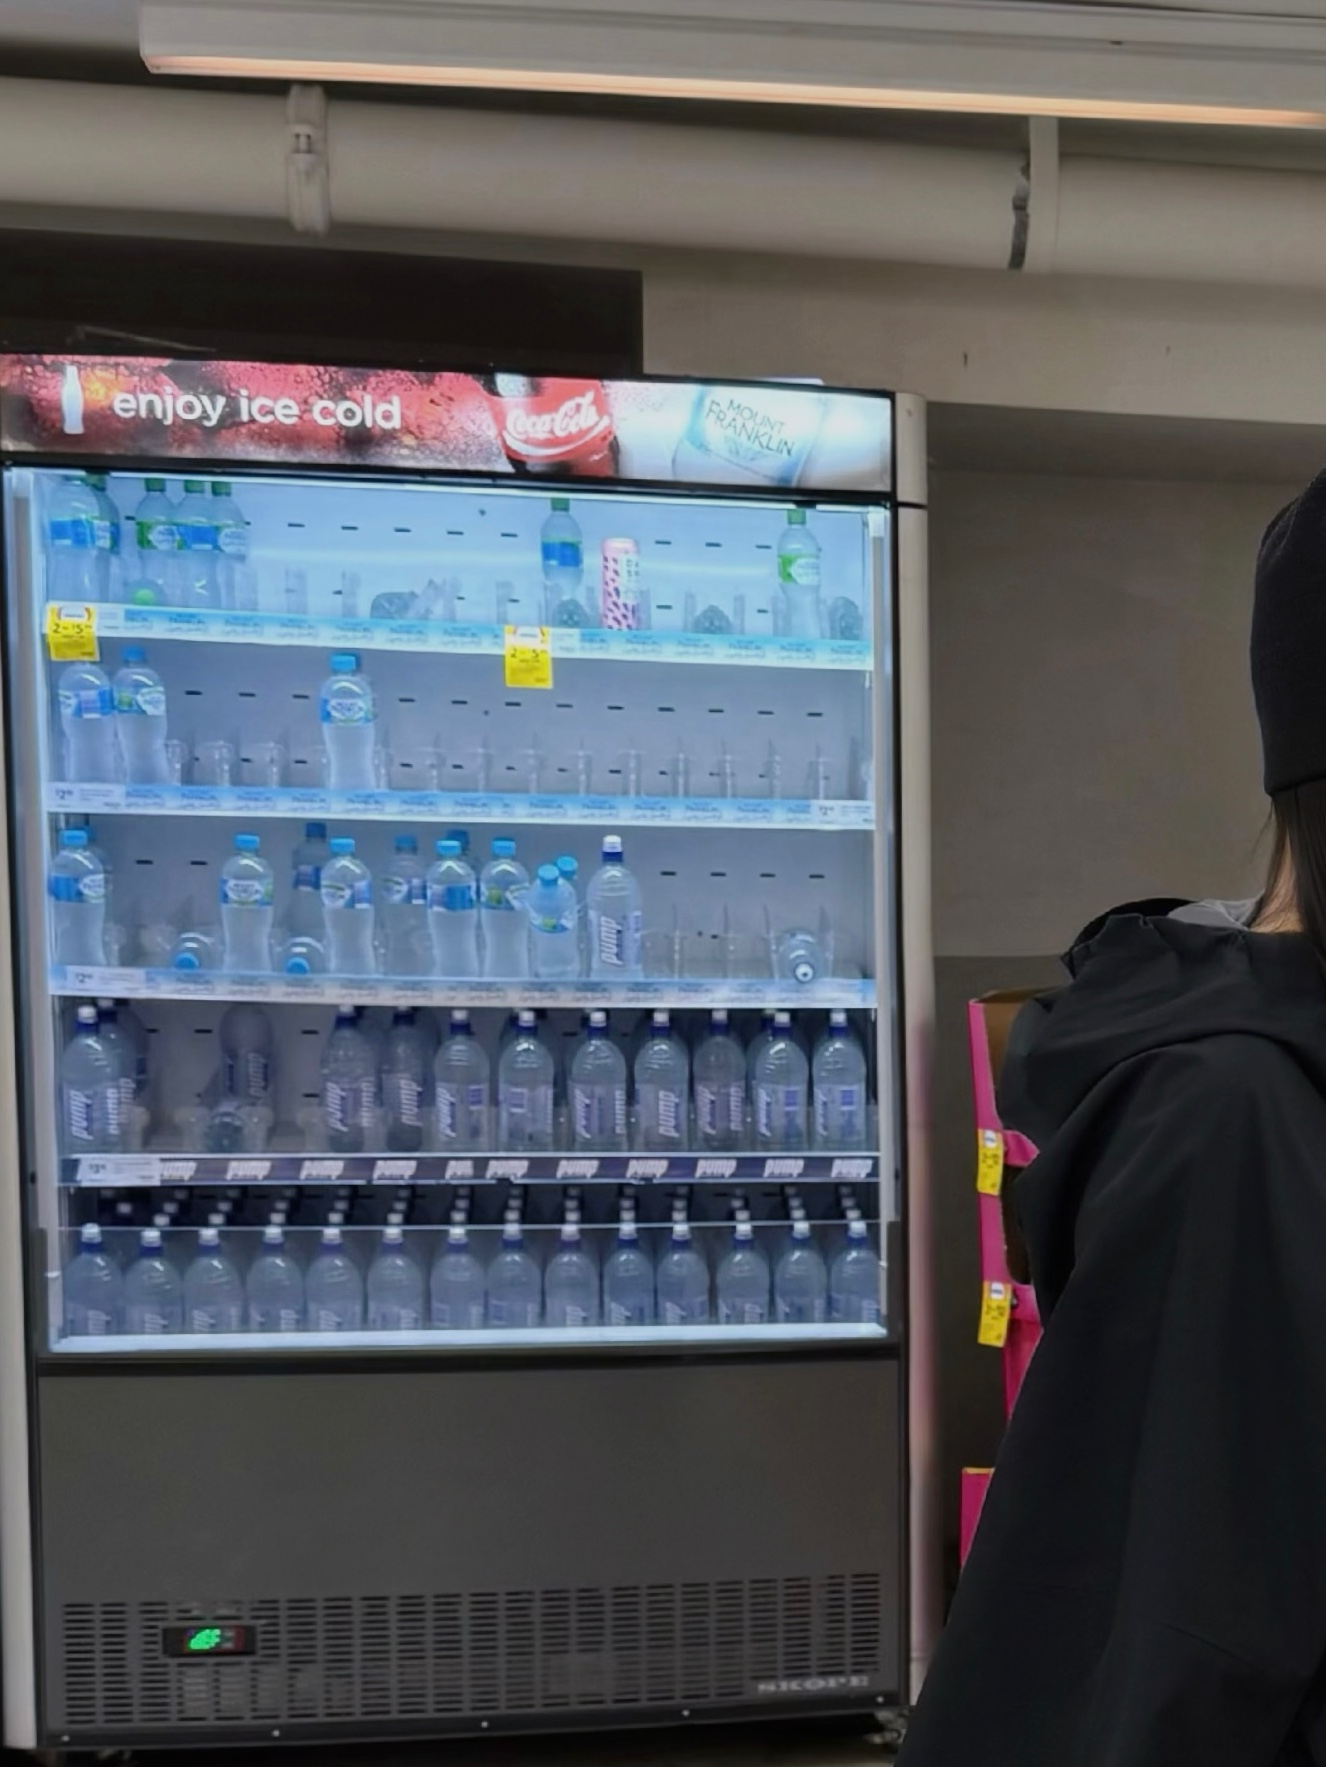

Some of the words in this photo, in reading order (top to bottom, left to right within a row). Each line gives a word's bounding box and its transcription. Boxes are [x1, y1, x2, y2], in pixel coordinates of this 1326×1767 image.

[112, 386, 226, 427] enjoy
[239, 389, 300, 424] ice
[312, 395, 400, 429] cold
[706, 400, 796, 457] FRANKLIN
[726, 400, 786, 435] MOUNT
